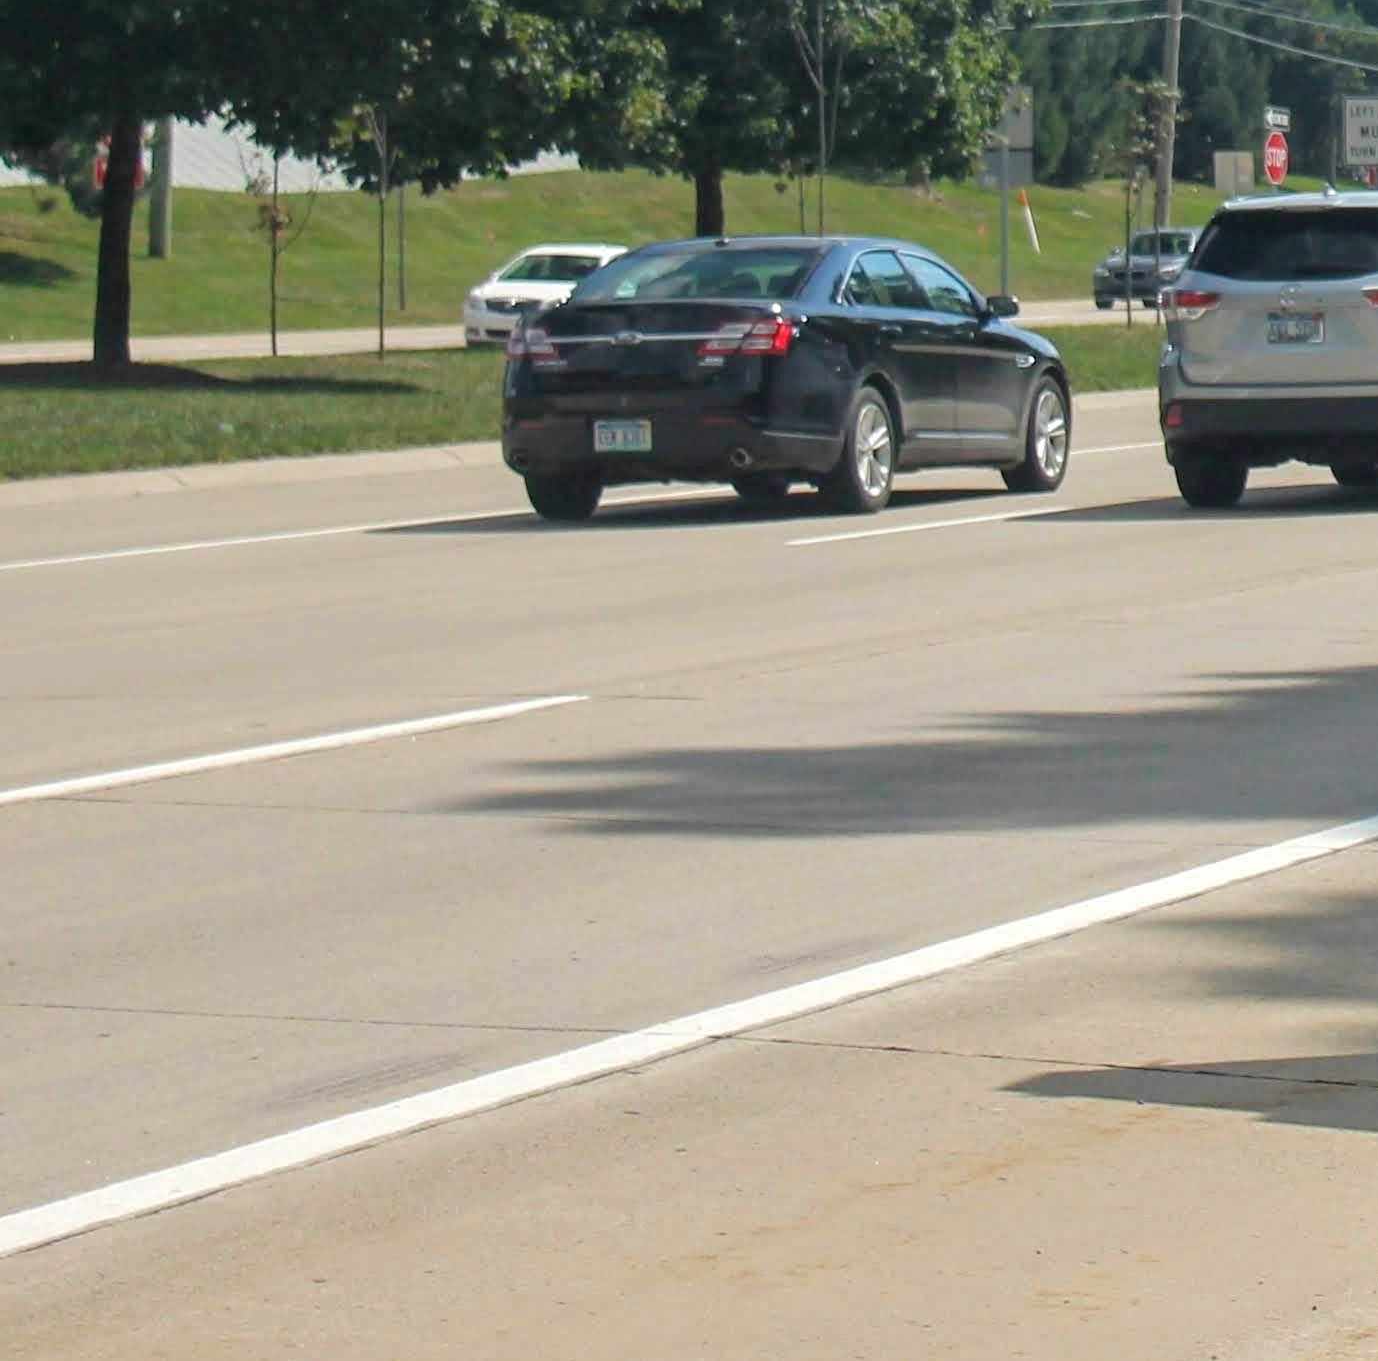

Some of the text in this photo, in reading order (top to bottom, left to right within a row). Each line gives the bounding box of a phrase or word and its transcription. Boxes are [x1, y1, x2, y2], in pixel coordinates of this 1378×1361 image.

[1351, 106, 1374, 118] LEFT
[1266, 148, 1287, 167] STOP
[1351, 148, 1376, 157] TURN
